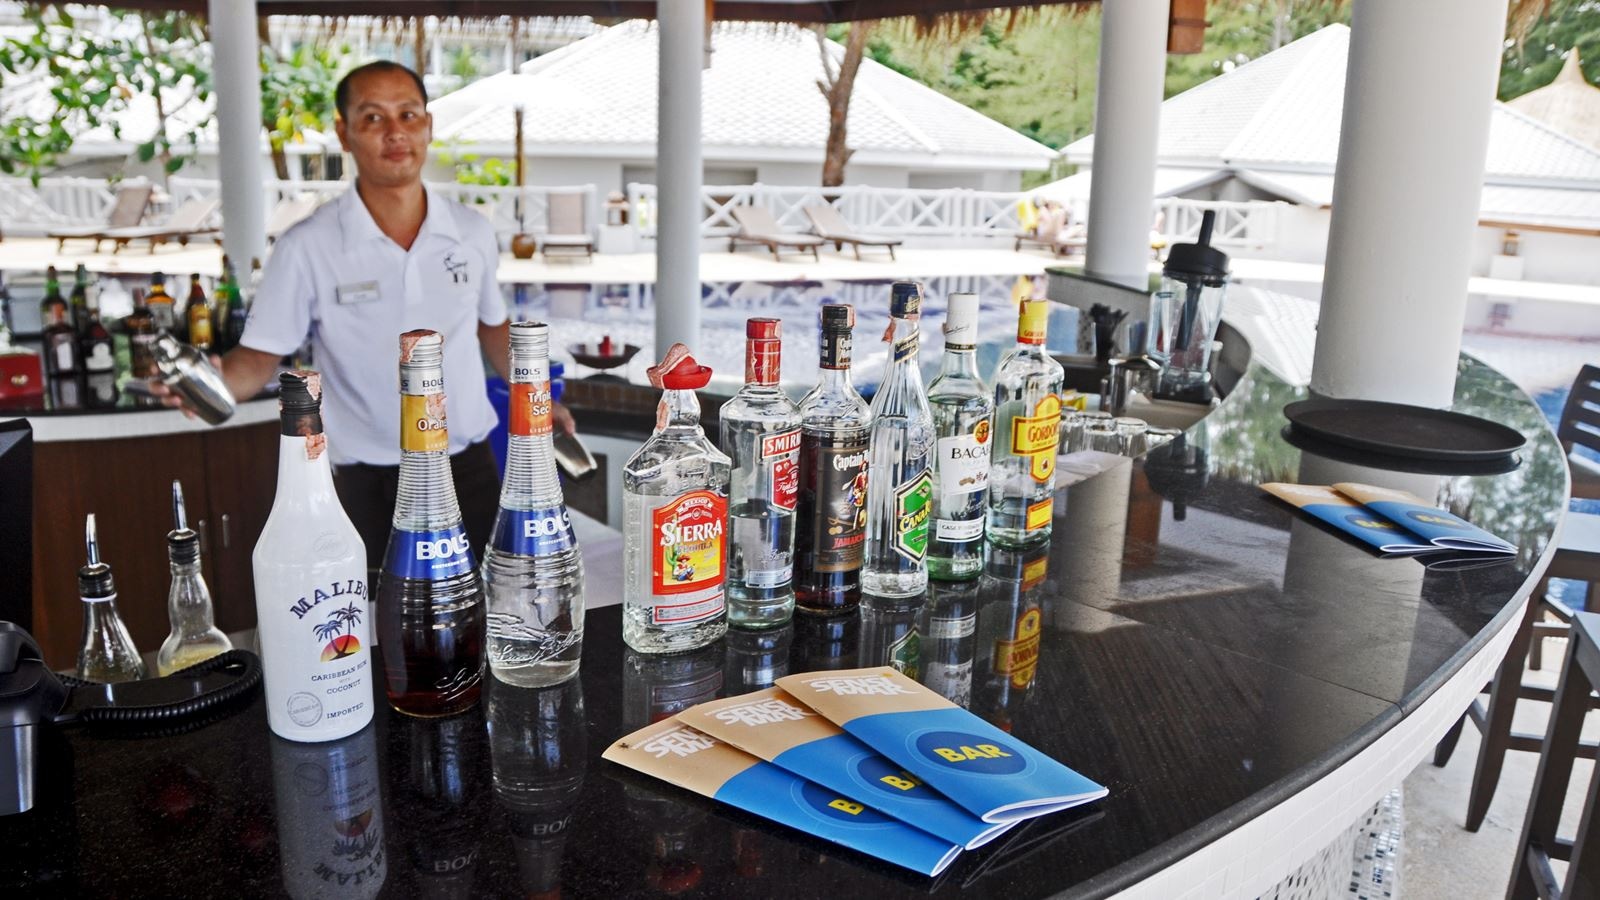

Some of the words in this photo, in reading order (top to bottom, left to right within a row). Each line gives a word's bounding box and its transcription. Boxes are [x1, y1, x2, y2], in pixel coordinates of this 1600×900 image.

[423, 378, 444, 388] BOLS
[532, 405, 550, 416] Sec
[833, 452, 863, 471] Captain
[524, 511, 570, 538] BOLS
[660, 518, 722, 546] SIERRA
[416, 532, 470, 560] BOLS
[290, 579, 368, 620] MALIBU
[311, 666, 356, 682] CARIBBEAN
[326, 678, 361, 694] COCONUT
[326, 702, 364, 719] IMPORTED
[933, 743, 1012, 763] BAR
